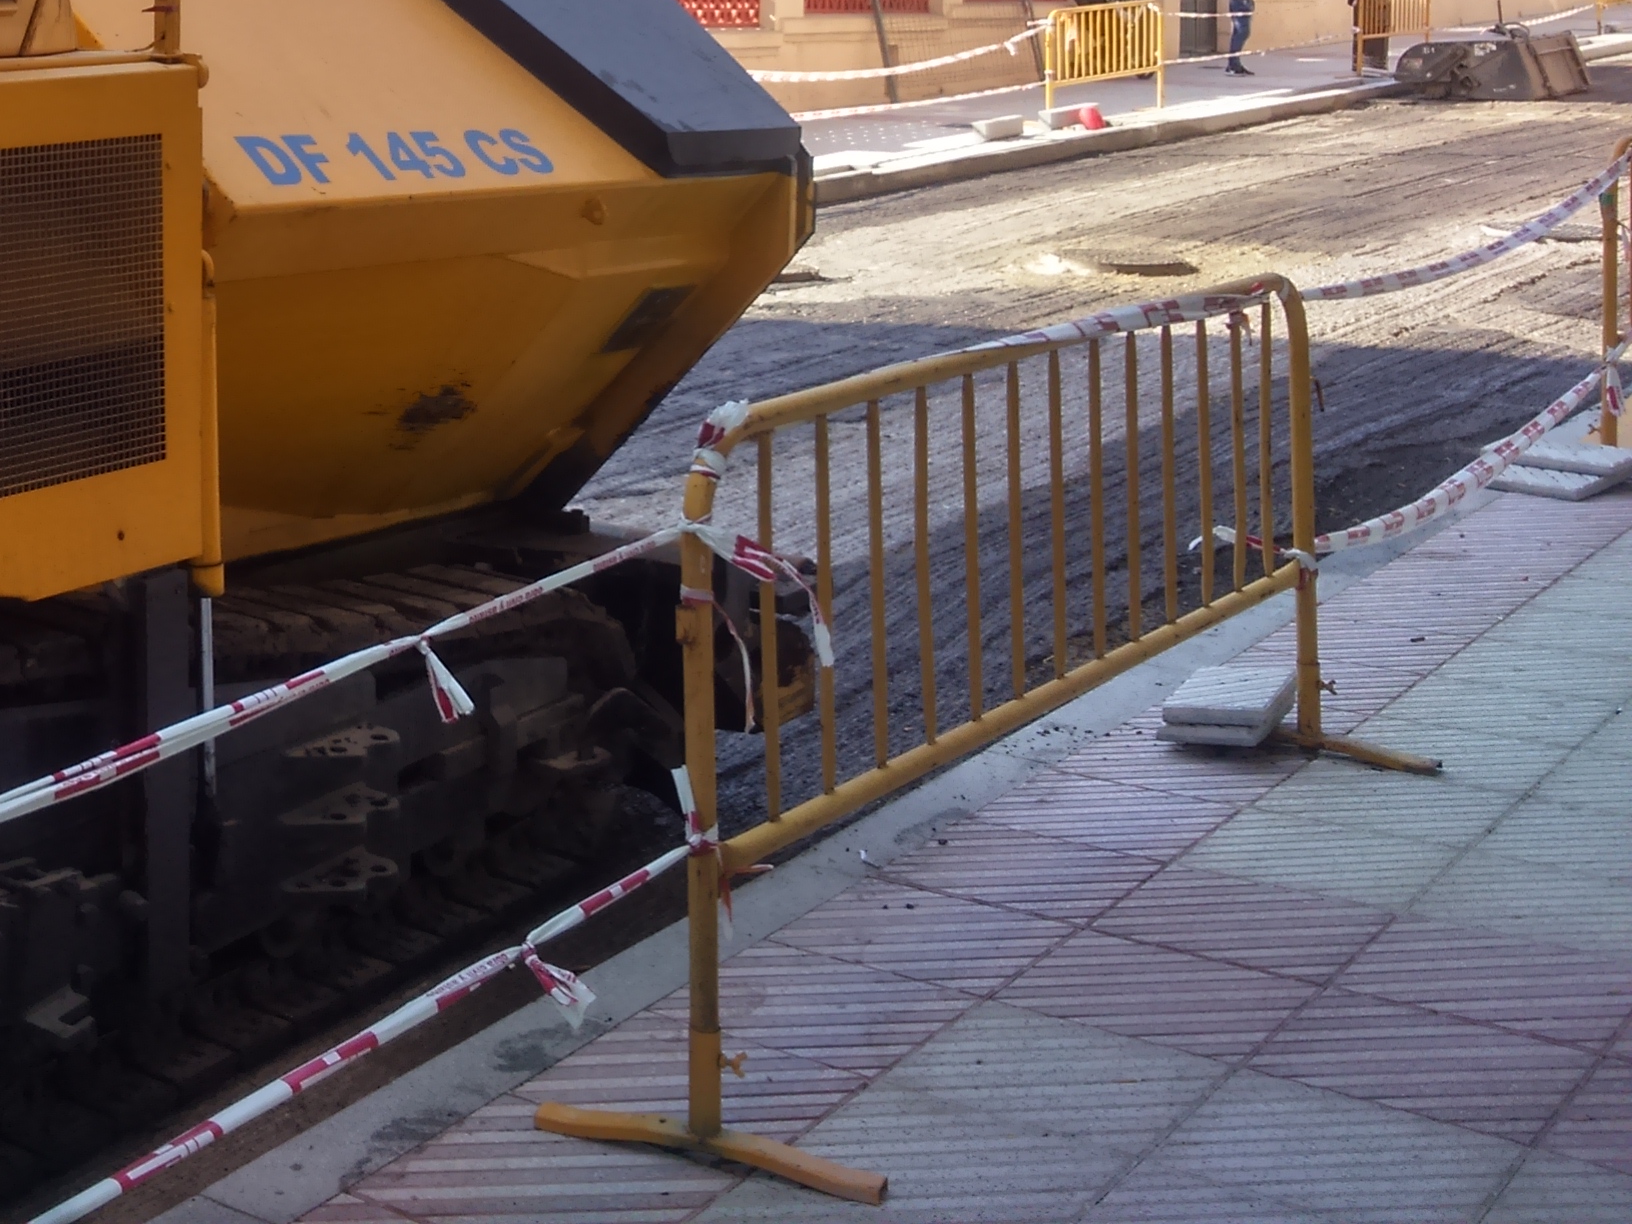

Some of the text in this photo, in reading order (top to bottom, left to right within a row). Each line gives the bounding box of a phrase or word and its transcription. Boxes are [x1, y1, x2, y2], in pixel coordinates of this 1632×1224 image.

[234, 128, 555, 186] DF 145 CS
